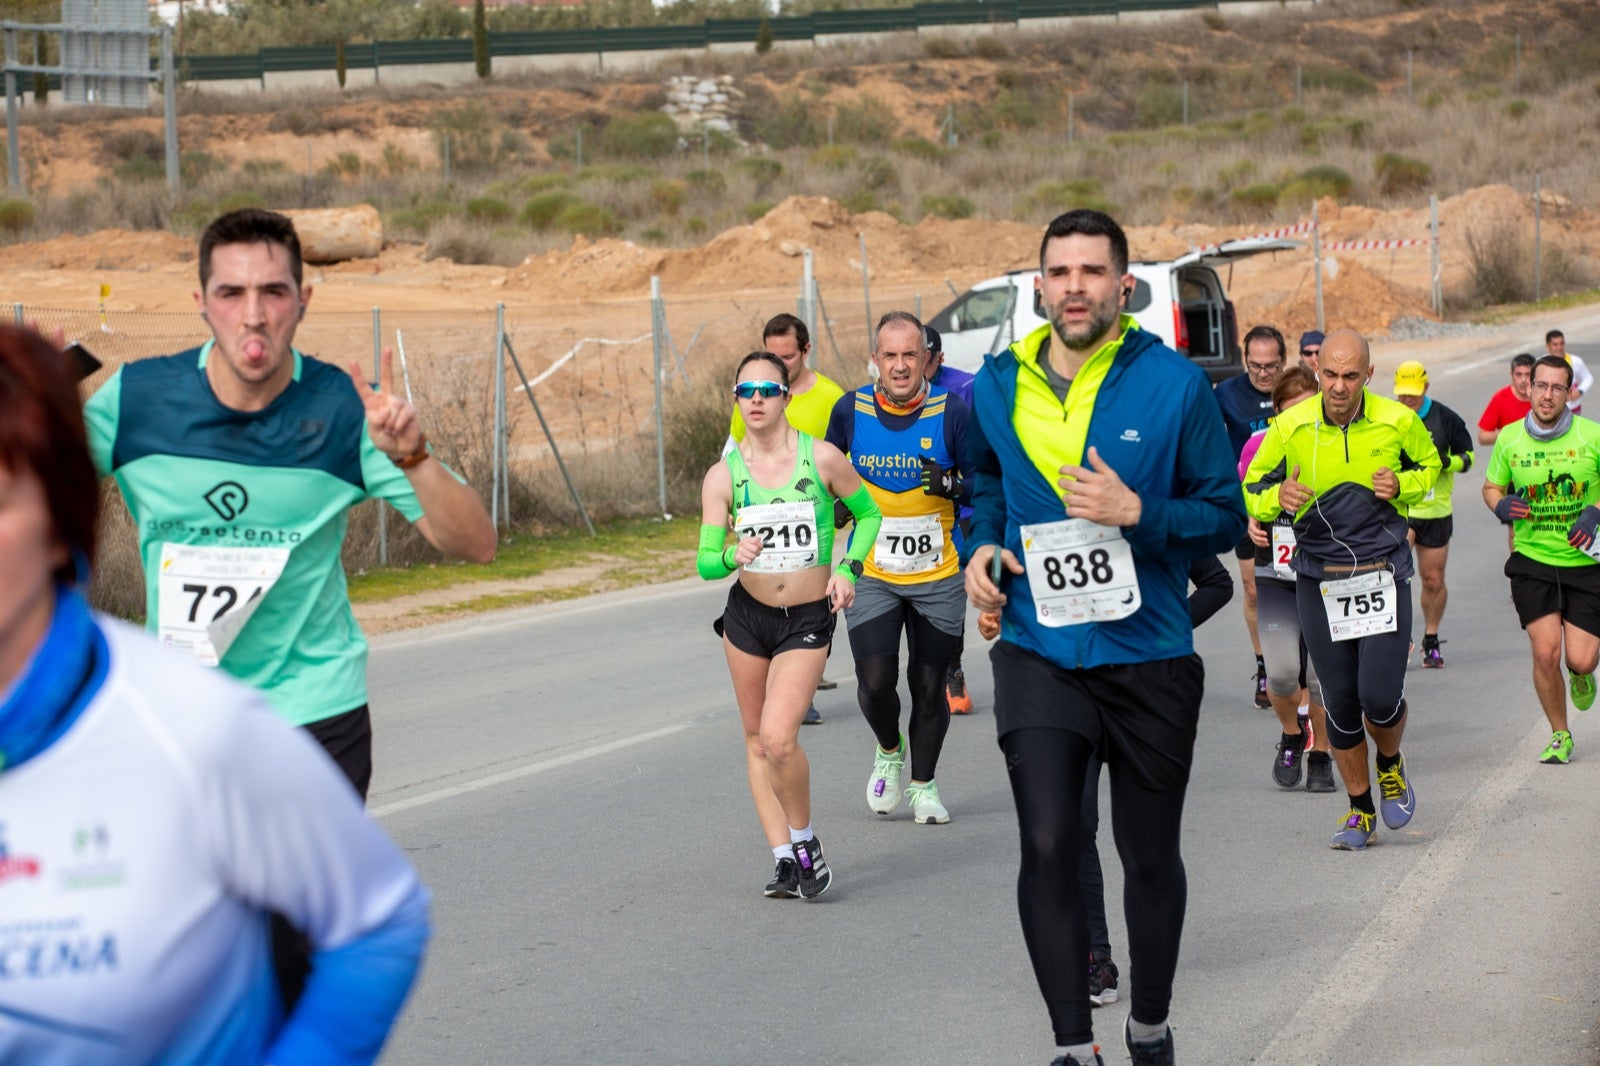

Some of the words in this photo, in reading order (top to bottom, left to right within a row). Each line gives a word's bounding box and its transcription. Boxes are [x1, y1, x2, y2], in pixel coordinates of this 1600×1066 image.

[859, 452, 936, 471] agustin
[868, 470, 922, 478] GRANAD
[886, 534, 932, 556] 708
[1277, 544, 1297, 565] 2
[1043, 548, 1113, 590] 838
[183, 583, 263, 623] 72
[1337, 590, 1385, 617] 755
